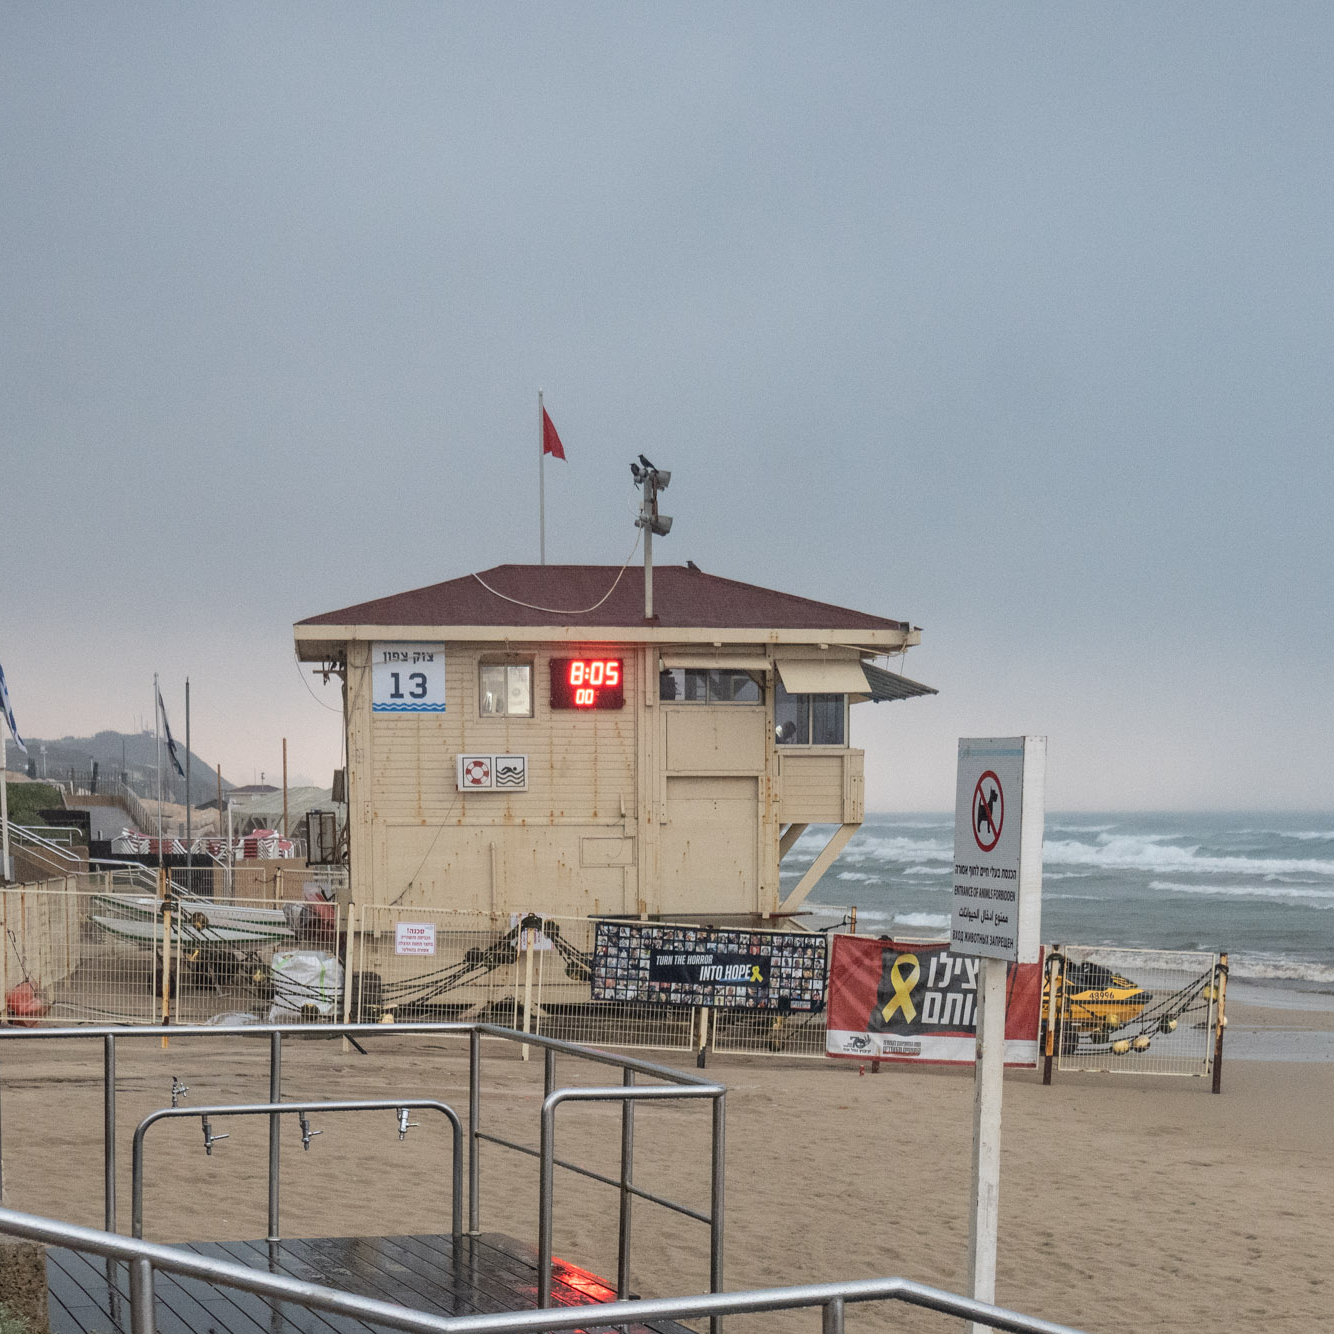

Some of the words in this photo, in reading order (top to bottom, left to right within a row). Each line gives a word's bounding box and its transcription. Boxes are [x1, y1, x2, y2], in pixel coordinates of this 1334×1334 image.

[383, 652, 408, 664] צפון
[413, 652, 434, 664] צוק
[570, 661, 619, 685] 8:05
[390, 672, 427, 699] 13
[954, 885, 973, 898] ENTRANCE
[973, 887, 979, 898] OF
[993, 889, 1016, 902] FORBIDDEN
[995, 912, 1008, 926] ممنوع
[953, 930, 964, 943] ВХОД
[964, 932, 989, 945] ЖИВОТНЫХ
[989, 935, 1014, 950] ЗАПРЕЩЕН
[656, 955, 673, 965] TURN
[674, 955, 686, 965] THE
[686, 954, 713, 965] HORROR
[699, 965, 723, 981] INTO
[725, 964, 751, 981] HOPE
[926, 952, 979, 989] צילו
[1089, 991, 1115, 1000] 48996
[921, 991, 977, 1026] ותם
